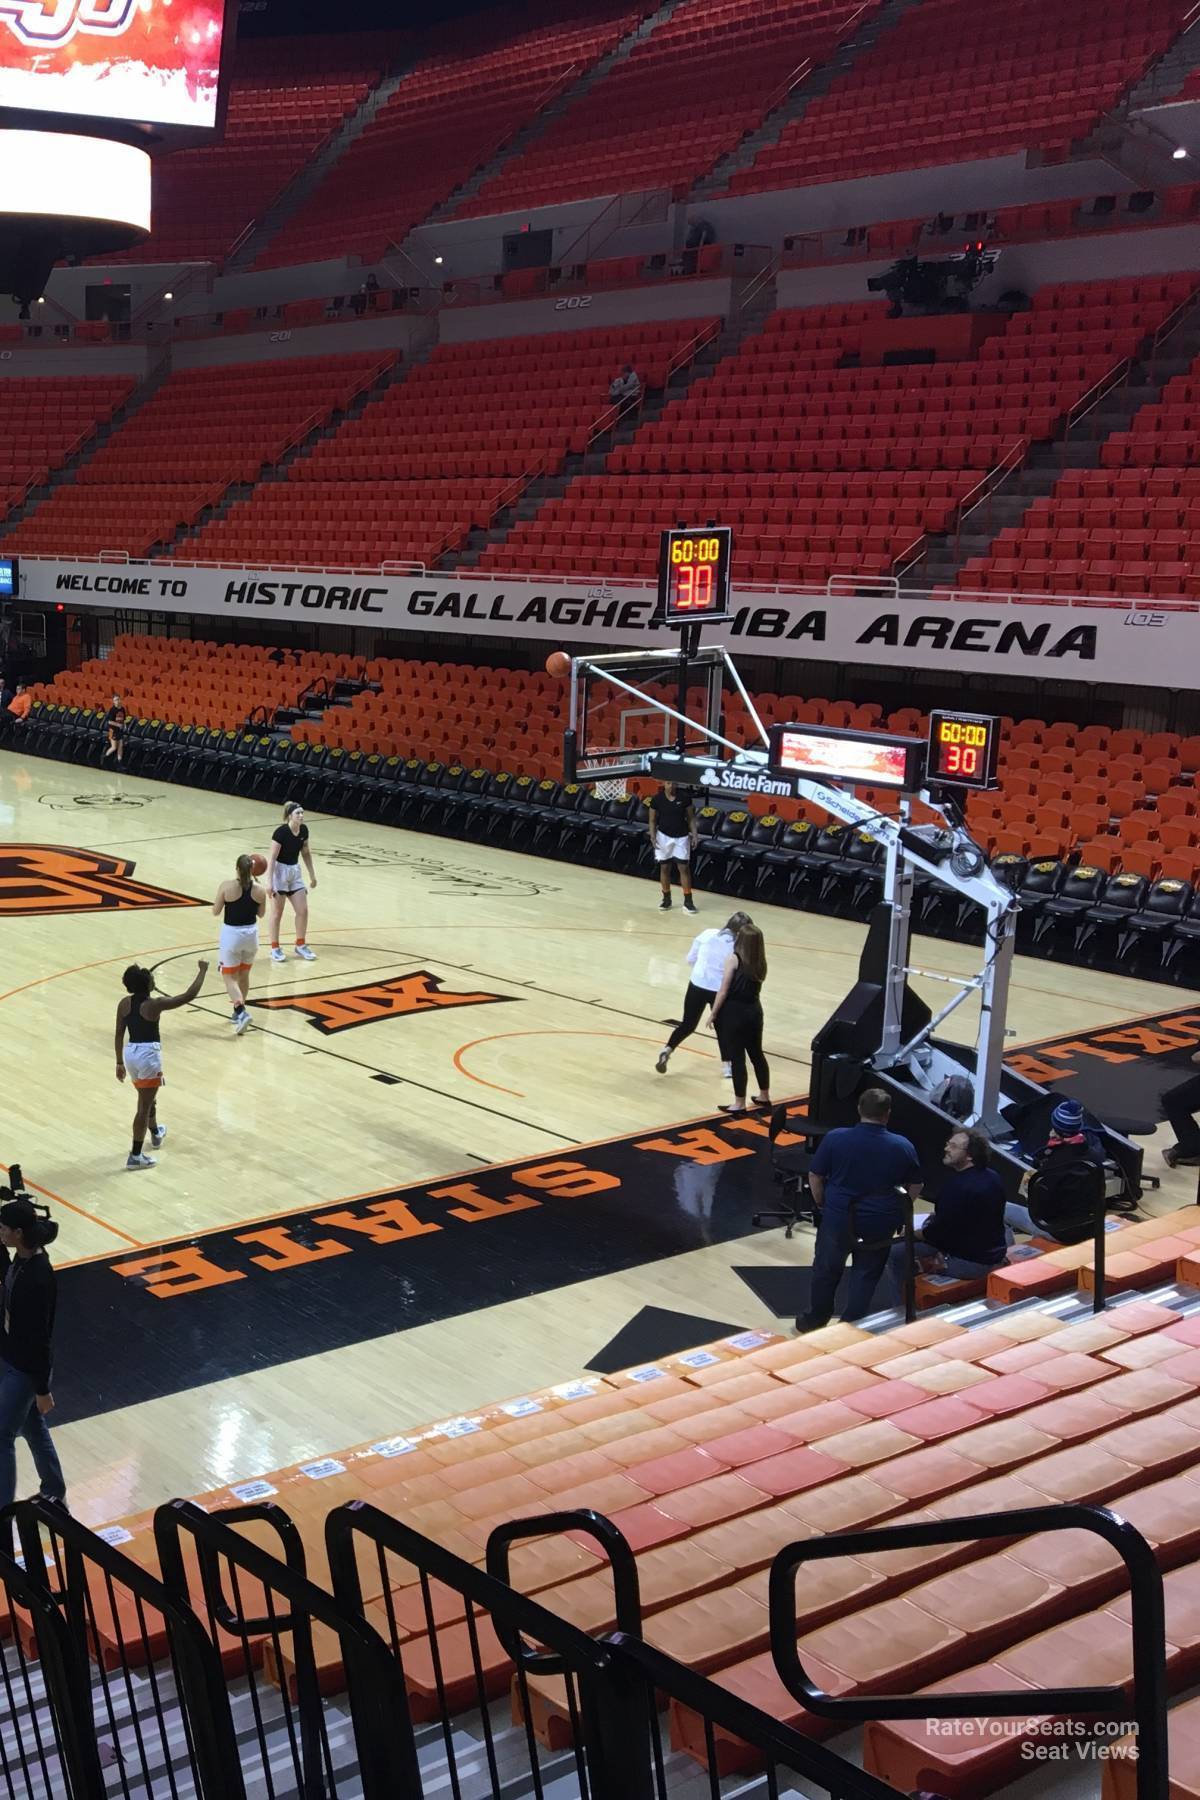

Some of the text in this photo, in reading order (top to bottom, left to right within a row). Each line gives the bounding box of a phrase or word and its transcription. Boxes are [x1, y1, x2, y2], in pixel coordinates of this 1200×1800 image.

[554, 295, 593, 310] 202
[269, 330, 292, 342] 201
[672, 538, 720, 563] 60:00
[587, 587, 614, 600] 102
[677, 565, 712, 607] 30
[55, 573, 152, 596] WELCOME
[158, 578, 188, 598] TO
[223, 580, 389, 613] HISTORIC
[853, 613, 1098, 660] ARENA
[1122, 612, 1169, 628] 103
[941, 721, 986, 747] 60:00
[947, 745, 977, 773] 30
[415, 857, 494, 877] SUTTON
[109, 1161, 622, 1299] STATE
